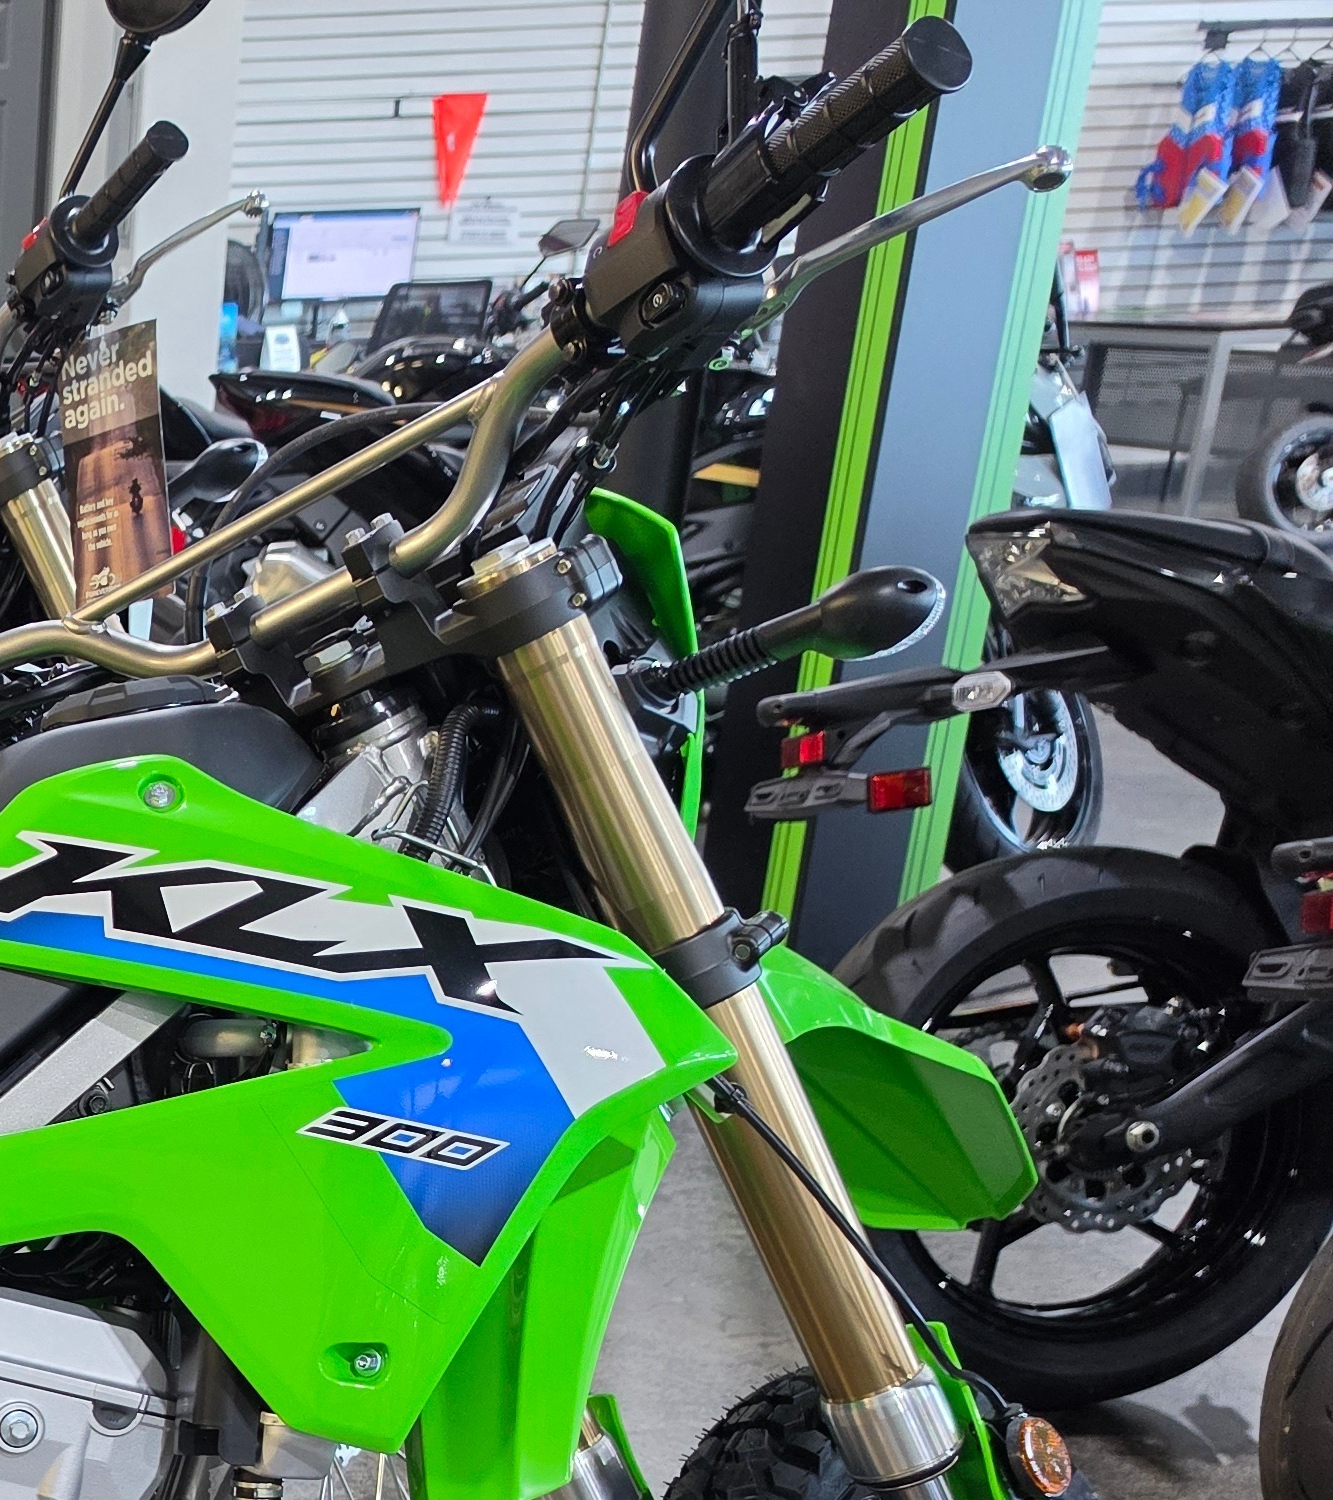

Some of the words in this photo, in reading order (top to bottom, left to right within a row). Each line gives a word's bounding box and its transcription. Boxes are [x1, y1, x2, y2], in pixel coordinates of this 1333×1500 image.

[61, 341, 120, 382] Never
[62, 349, 153, 405] stranded
[64, 392, 125, 430] again.
[302, 1108, 506, 1168] 300
